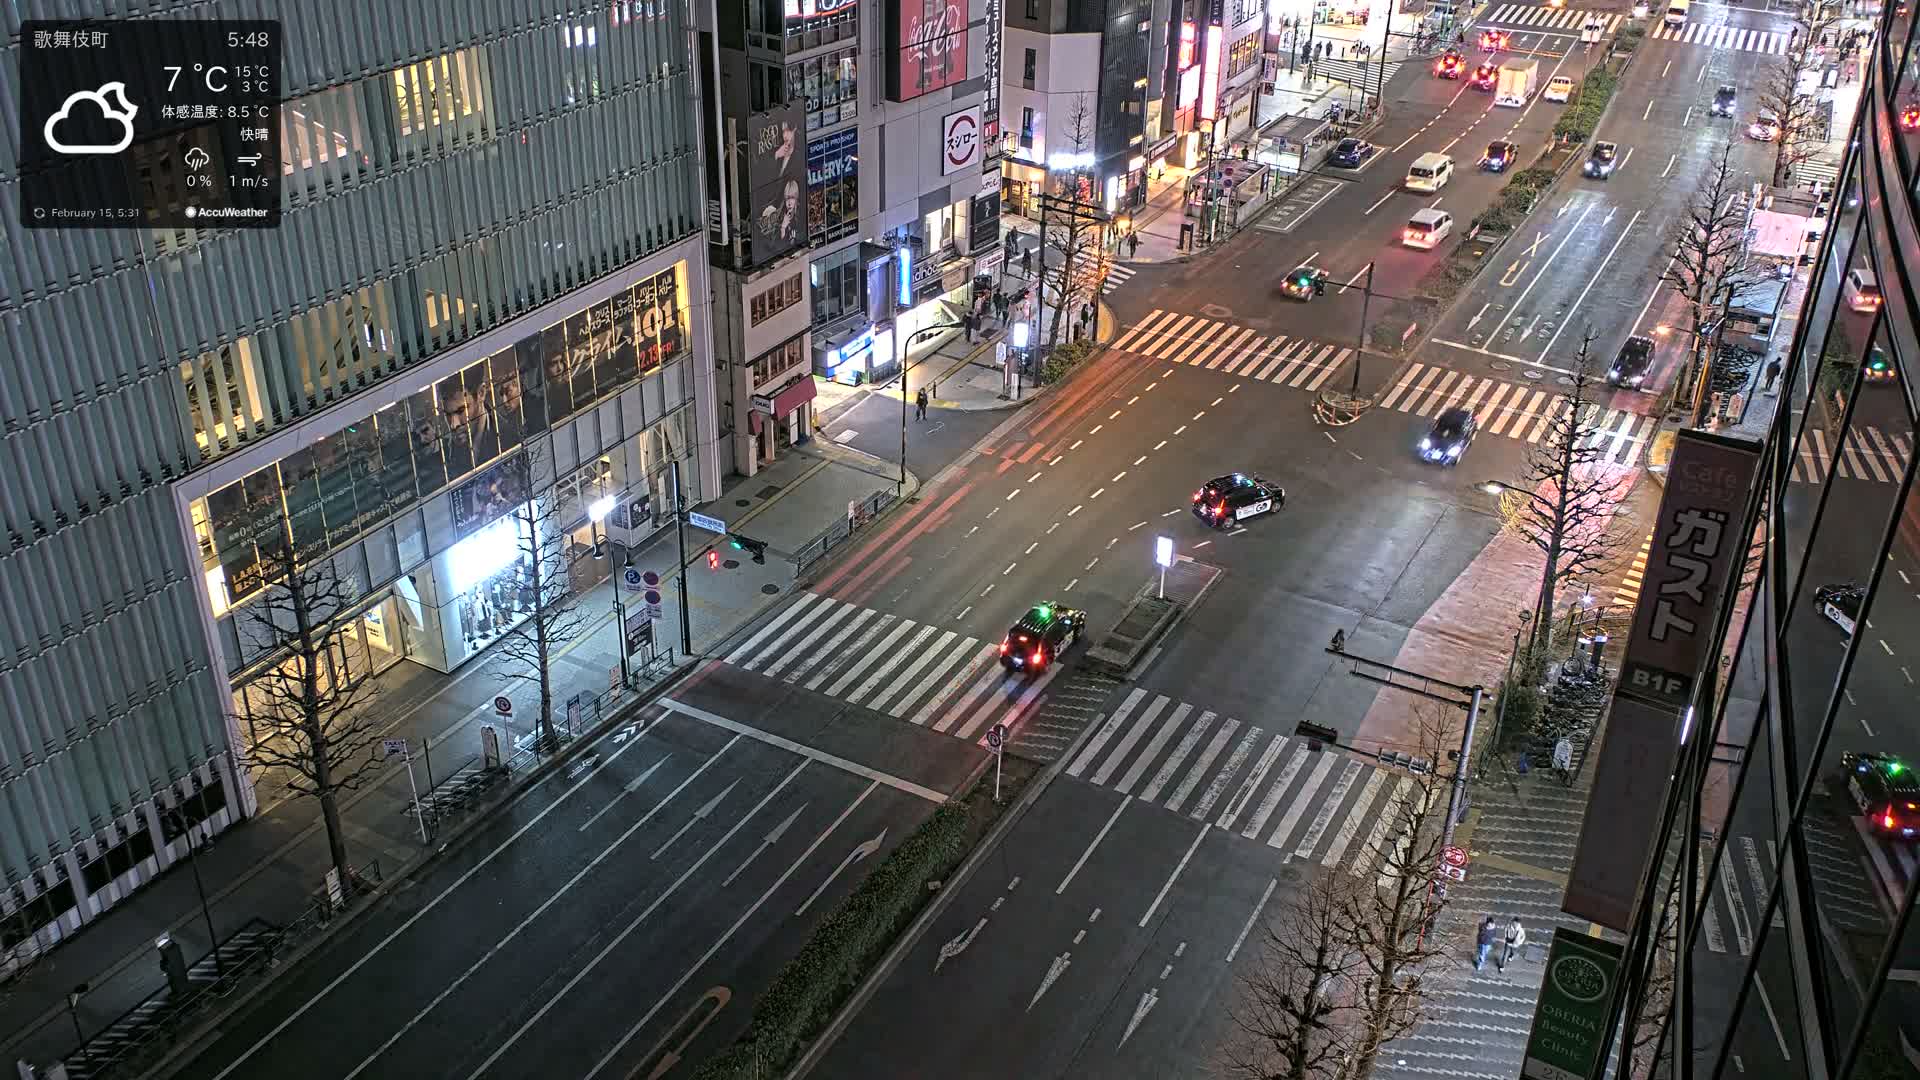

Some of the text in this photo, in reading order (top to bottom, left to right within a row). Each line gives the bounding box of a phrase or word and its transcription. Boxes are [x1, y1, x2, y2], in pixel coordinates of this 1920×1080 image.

[810, 140, 829, 153] SPORTS
[946, 132, 978, 152] スシロー
[709, 199, 721, 233] MUJI
[632, 299, 676, 346] 101
[1650, 508, 1727, 641] ガスト
[1631, 667, 1683, 694] B1F
[1541, 1003, 1597, 1033] OBERIA
